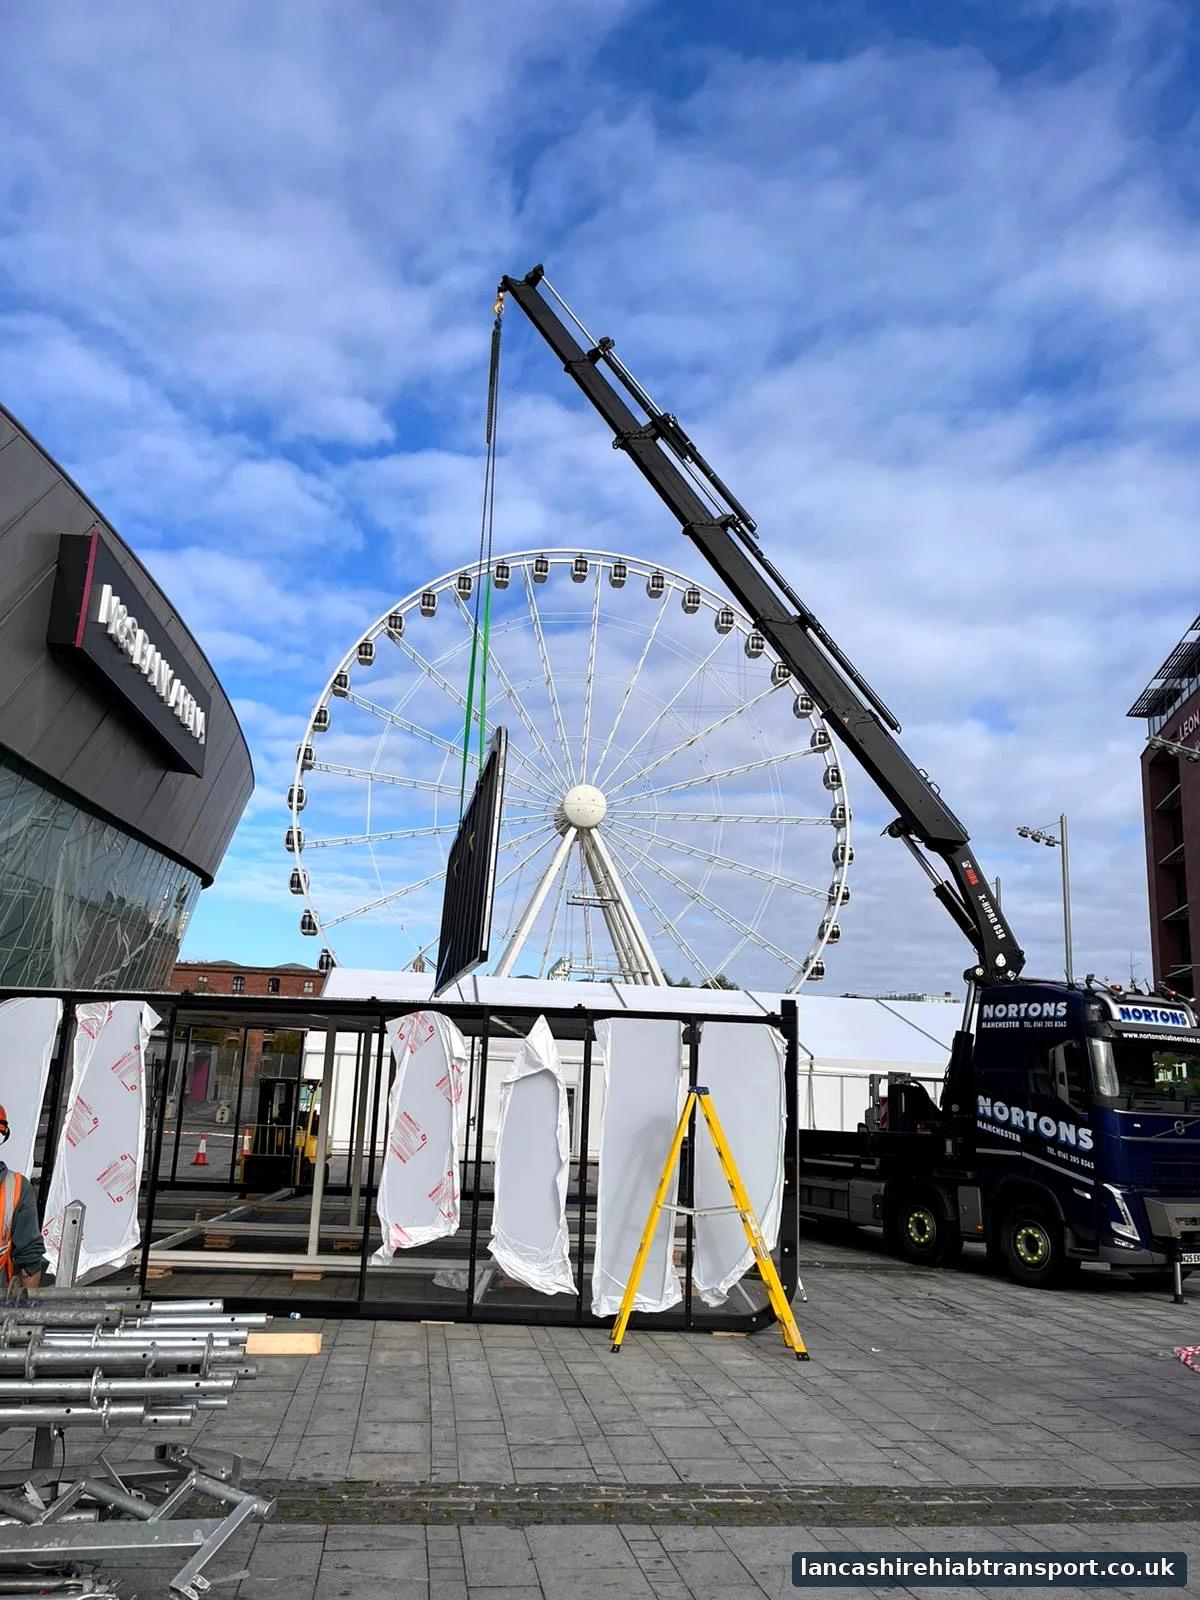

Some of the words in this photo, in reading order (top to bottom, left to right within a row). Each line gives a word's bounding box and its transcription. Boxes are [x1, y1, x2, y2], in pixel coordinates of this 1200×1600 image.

[982, 1002, 1067, 1019] NORTONS
[1119, 1006, 1187, 1026] NORTONS
[981, 1020, 1020, 1028] MANCHESTER
[976, 1094, 1094, 1151] NORTONS
[976, 1120, 1021, 1142] MANCHESTER
